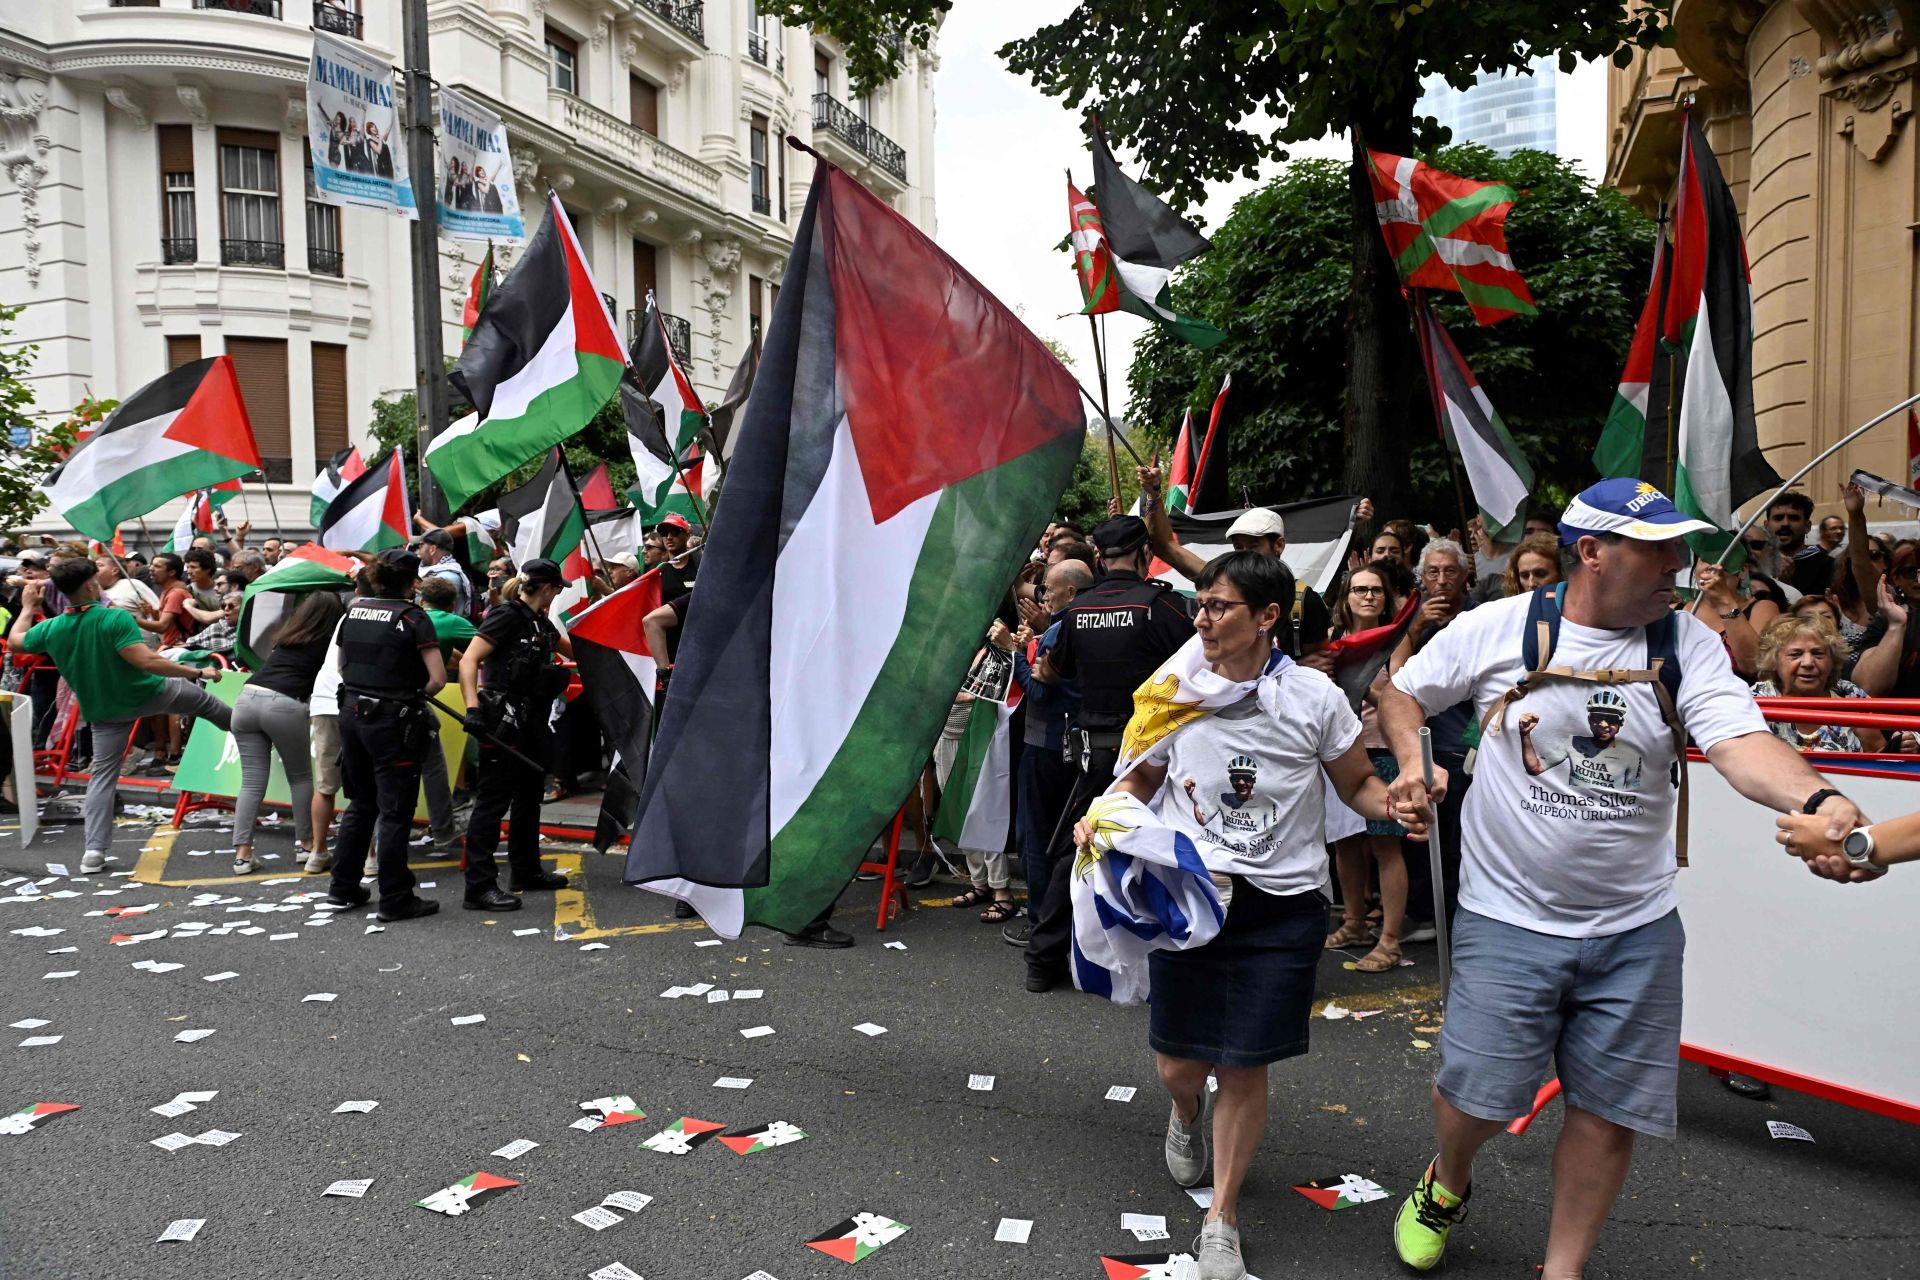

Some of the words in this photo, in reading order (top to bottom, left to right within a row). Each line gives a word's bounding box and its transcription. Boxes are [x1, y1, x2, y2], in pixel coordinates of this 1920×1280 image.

[315, 55, 361, 98] MAMMA
[363, 77, 393, 108] MIA!
[442, 108, 473, 146] MAMMA
[475, 127, 502, 153] MIA!
[348, 607, 393, 622] ERTZAINTZA
[1076, 611, 1134, 629] ERTZAINTZA
[395, 619, 404, 632] A
[1574, 764, 1615, 783] RURAL
[1581, 759, 1608, 773] CAJA
[1529, 785, 1595, 807] Thomas
[1599, 793, 1637, 808] Silva
[1230, 810, 1252, 820] CAJA
[1520, 799, 1577, 820] CAMPEÓN
[1581, 804, 1645, 821] URUGUAYO
[1225, 815, 1257, 828] RURAL
[1204, 828, 1247, 852] Thas
